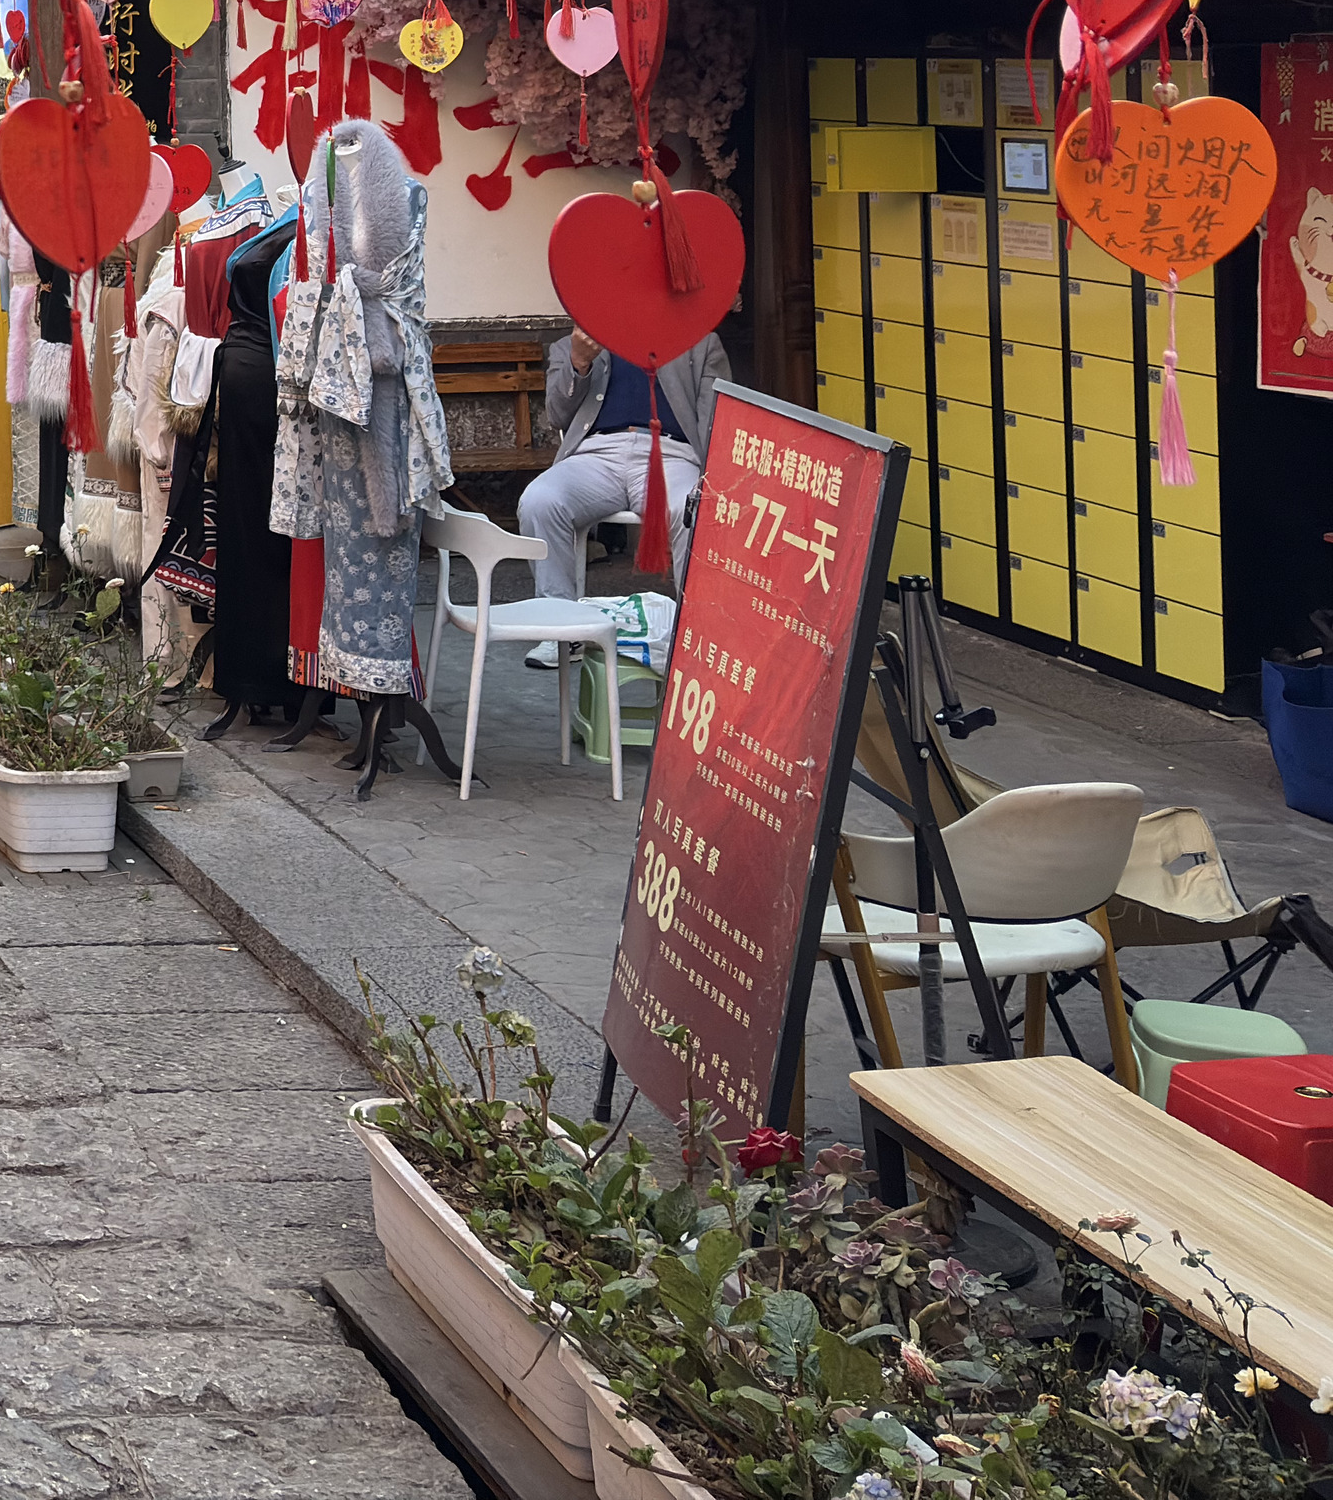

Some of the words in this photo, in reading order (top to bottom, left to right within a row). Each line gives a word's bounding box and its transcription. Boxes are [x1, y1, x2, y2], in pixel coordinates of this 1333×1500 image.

[732, 428, 843, 507] 租衣服+精致妆造
[743, 493, 839, 595] 77一天
[682, 626, 767, 695] 单人写真套餐
[666, 668, 717, 756] 198
[695, 760, 783, 834] 可免费换一套同系列服装自拍
[652, 798, 722, 877] 双人写真套餐
[637, 839, 681, 933] 388
